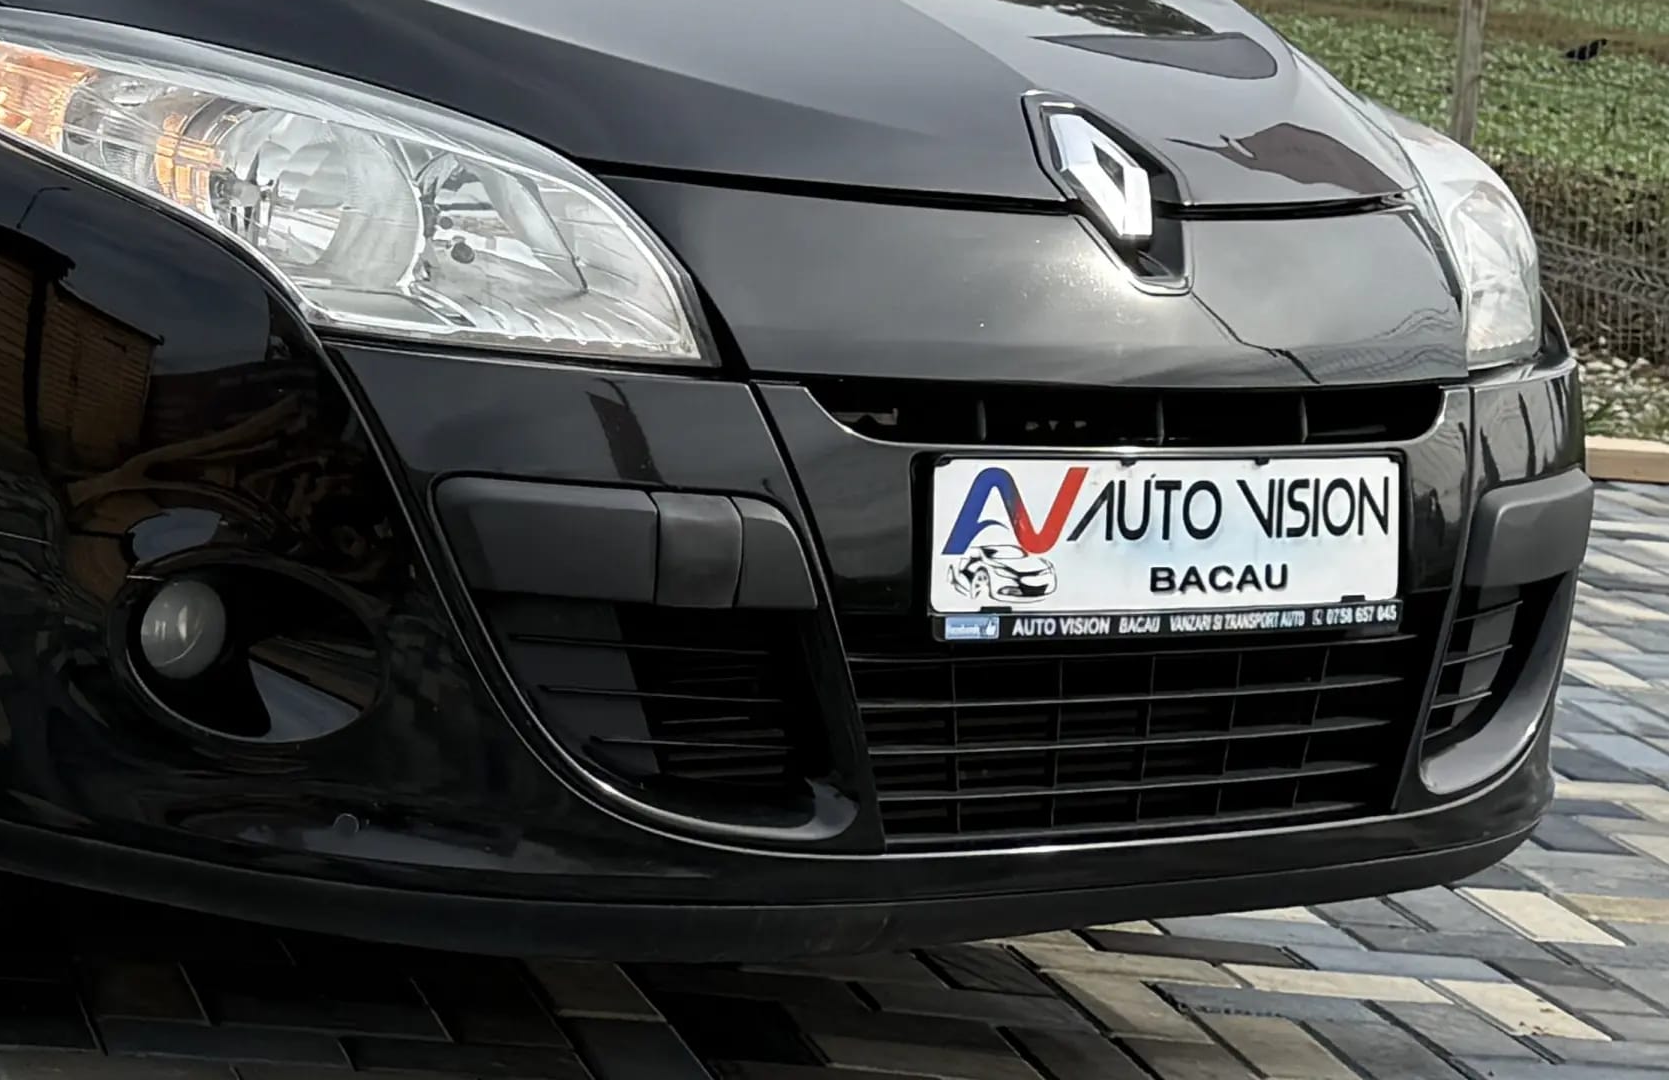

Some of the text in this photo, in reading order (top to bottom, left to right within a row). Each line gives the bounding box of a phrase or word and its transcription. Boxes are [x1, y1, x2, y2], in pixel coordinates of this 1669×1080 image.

[1067, 476, 1222, 542] AUTO
[1236, 476, 1391, 539] VISION
[1149, 563, 1289, 593] BACAU
[1011, 618, 1056, 637] AUTO
[1060, 616, 1111, 635] VISION
[1118, 616, 1160, 634] BACAU
[1224, 611, 1279, 630] TRANSPORT
[1280, 610, 1306, 628] AUTO
